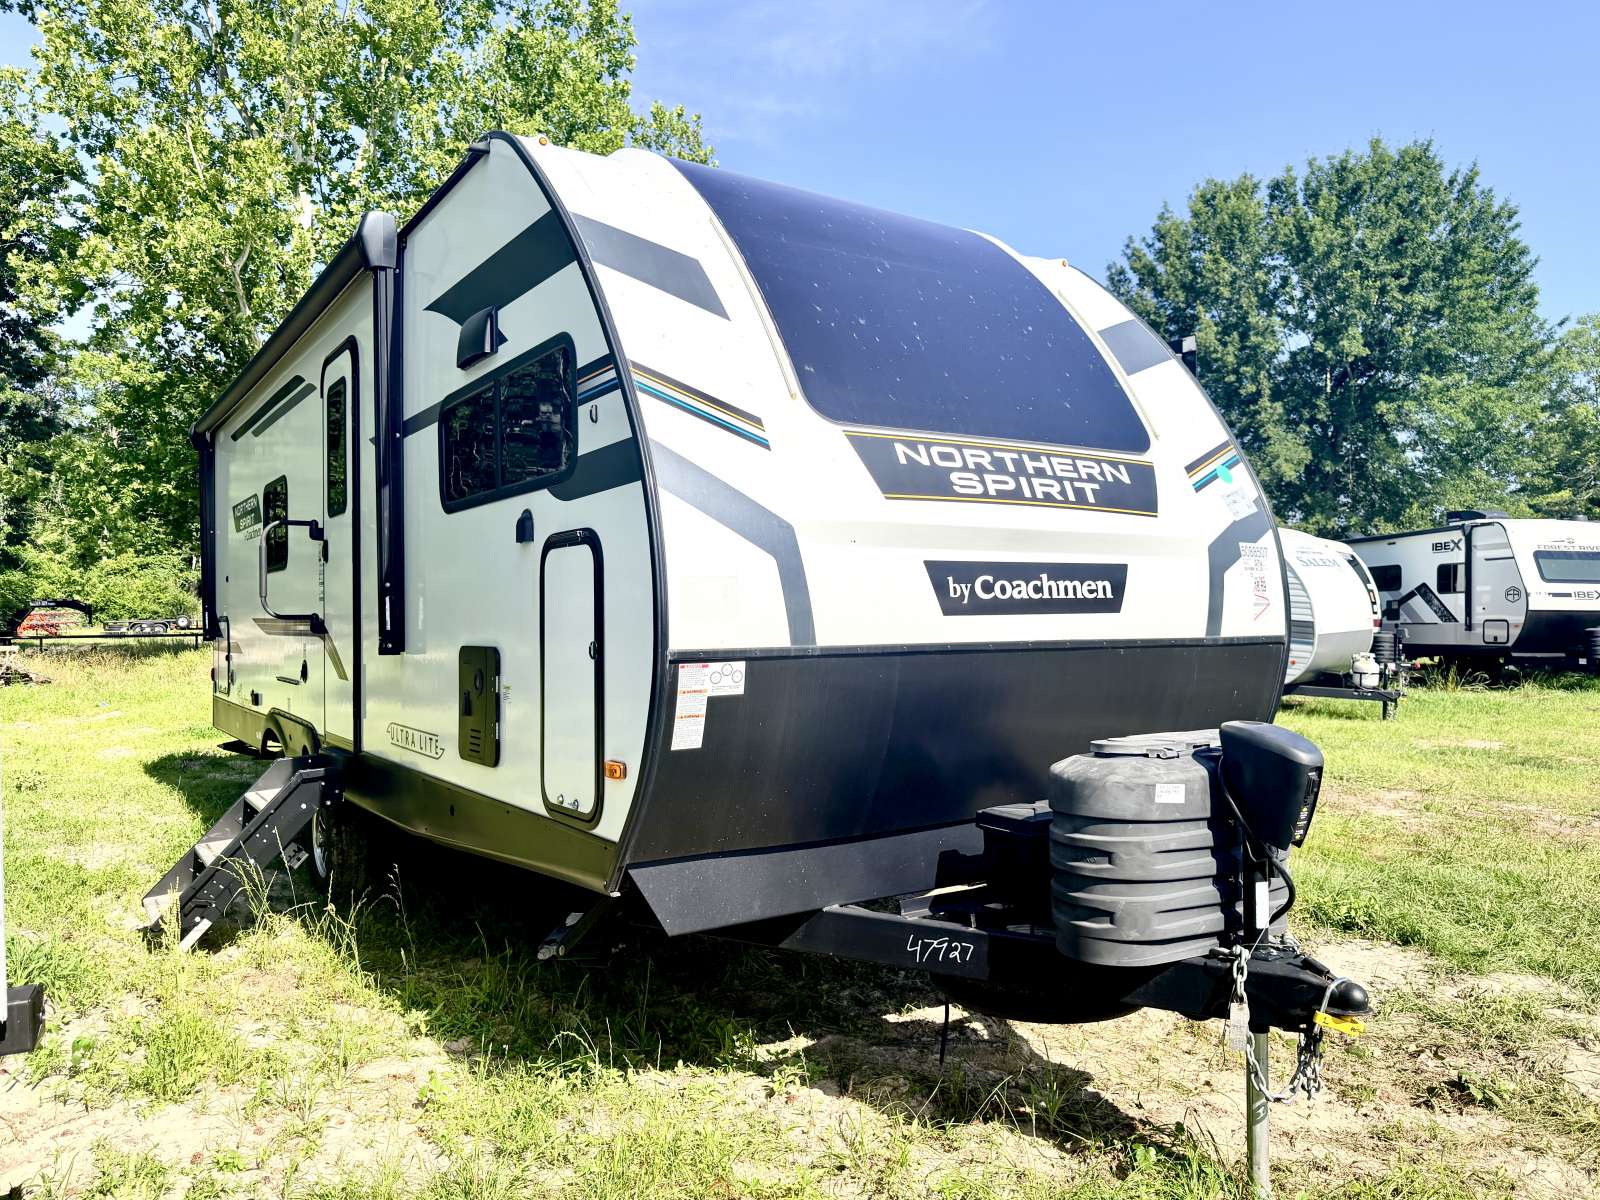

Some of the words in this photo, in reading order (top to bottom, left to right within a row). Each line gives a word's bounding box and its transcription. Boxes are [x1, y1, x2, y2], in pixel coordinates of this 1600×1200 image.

[893, 442, 1131, 484] NORTHERN
[950, 472, 1100, 504] SPIRIT
[1431, 538, 1463, 551] IBEX
[946, 576, 972, 604] by
[974, 574, 1113, 600] Coachmen
[390, 726, 416, 749] ULTRA
[419, 734, 439, 756] LITE
[906, 934, 975, 963] 47927
